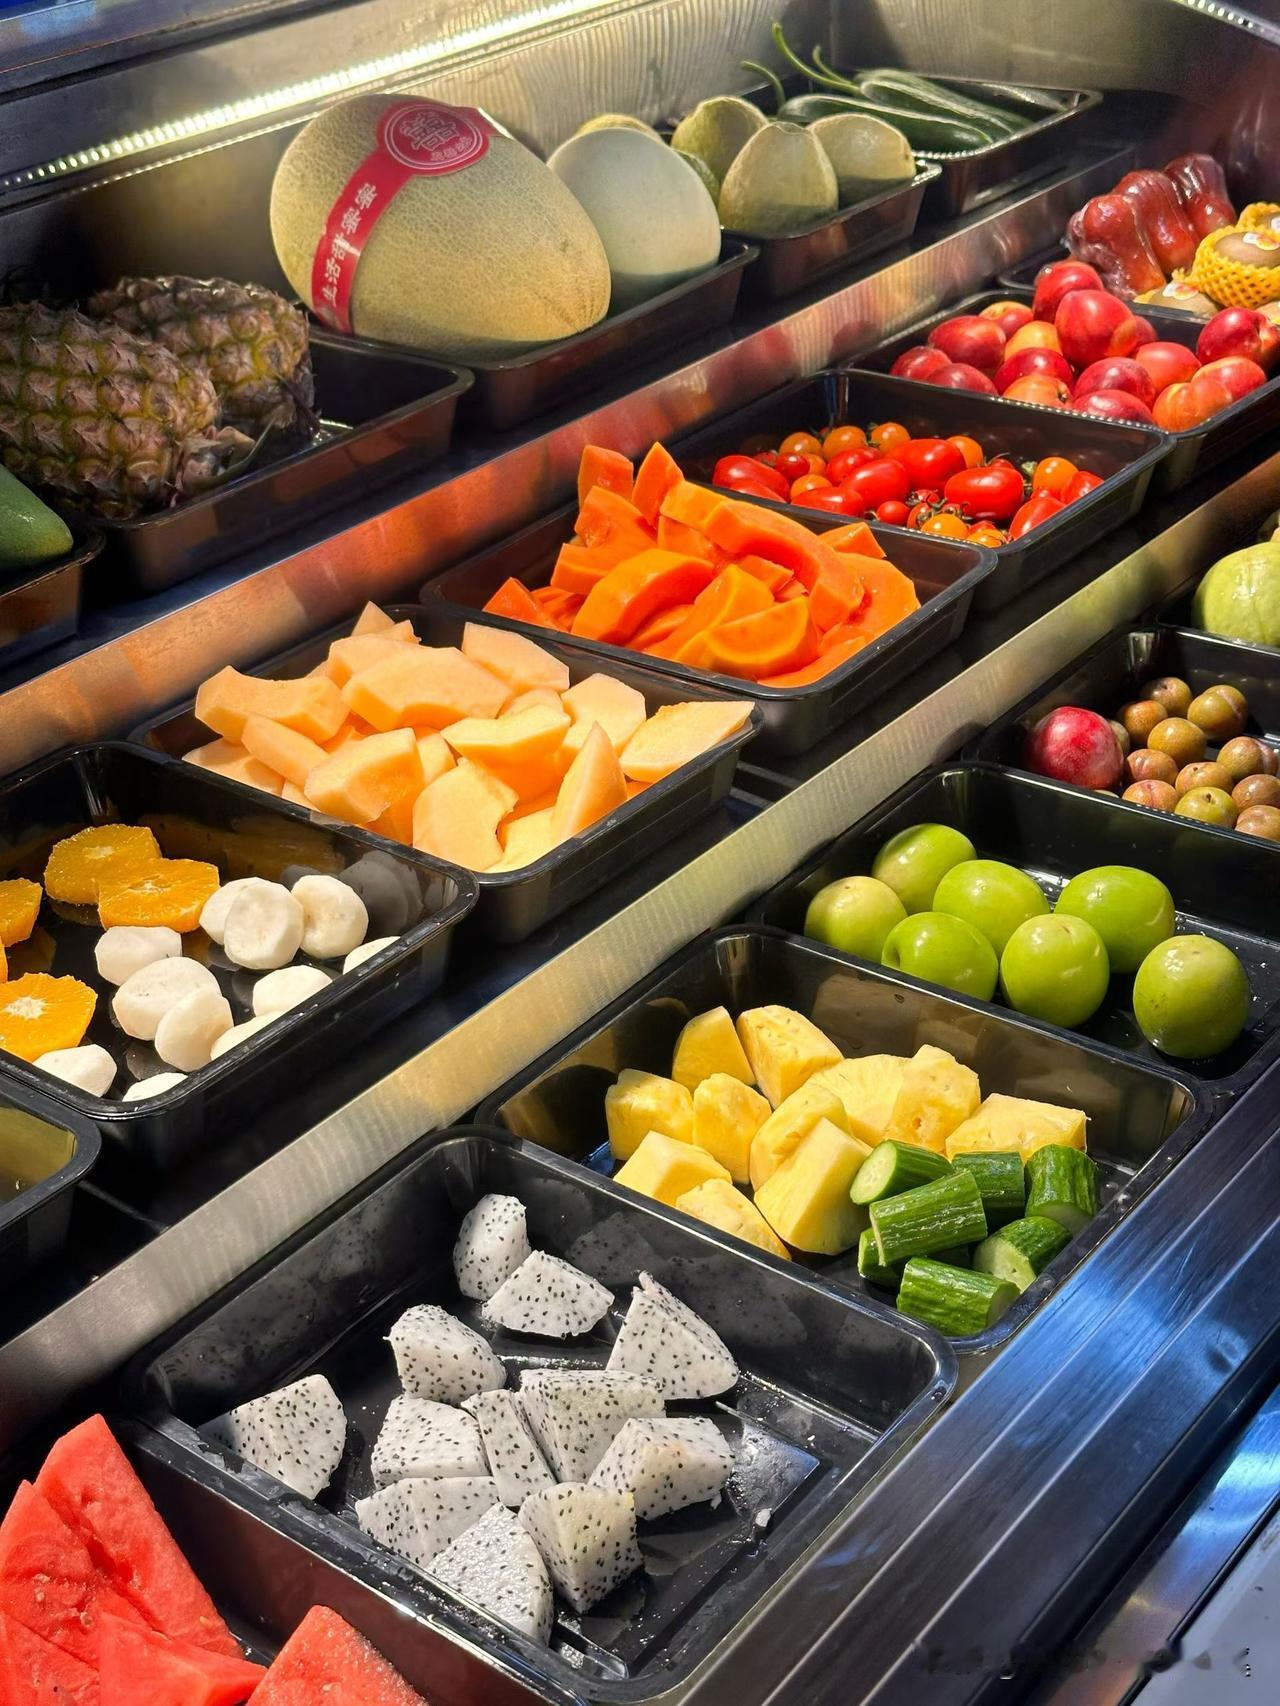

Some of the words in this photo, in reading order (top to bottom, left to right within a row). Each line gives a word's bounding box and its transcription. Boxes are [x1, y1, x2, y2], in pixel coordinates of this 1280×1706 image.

[321, 182, 379, 308] 生活甜蜜蜜
